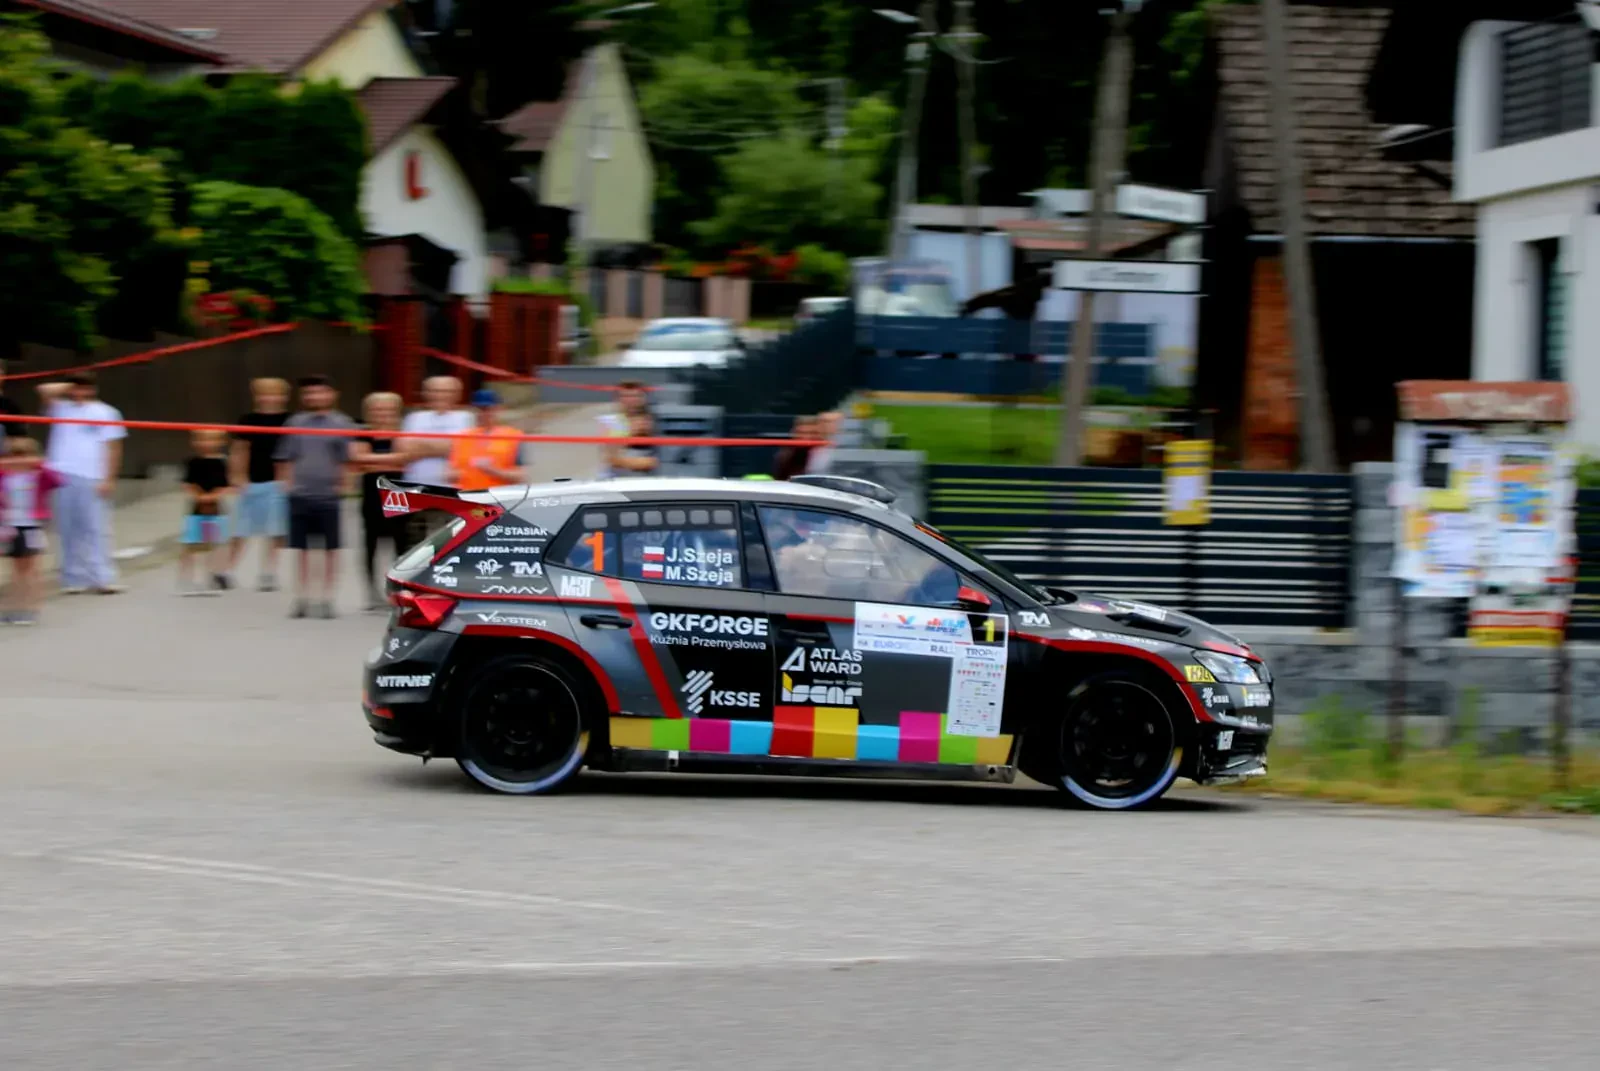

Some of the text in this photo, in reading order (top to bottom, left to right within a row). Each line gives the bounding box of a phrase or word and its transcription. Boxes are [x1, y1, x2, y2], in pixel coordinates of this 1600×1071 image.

[504, 526, 548, 536] STASIAK
[485, 546, 540, 554] MEGA-PRESS
[584, 531, 604, 573] 1
[666, 547, 733, 565] J.Szeja
[510, 561, 543, 575] TM
[665, 566, 734, 586] M.Szeja
[651, 612, 769, 636] GKFORGE
[1017, 611, 1051, 625] TM
[983, 618, 996, 643] 1
[810, 647, 863, 661] ATLAS
[810, 661, 862, 675] WARD
[709, 690, 761, 708] KSSE
